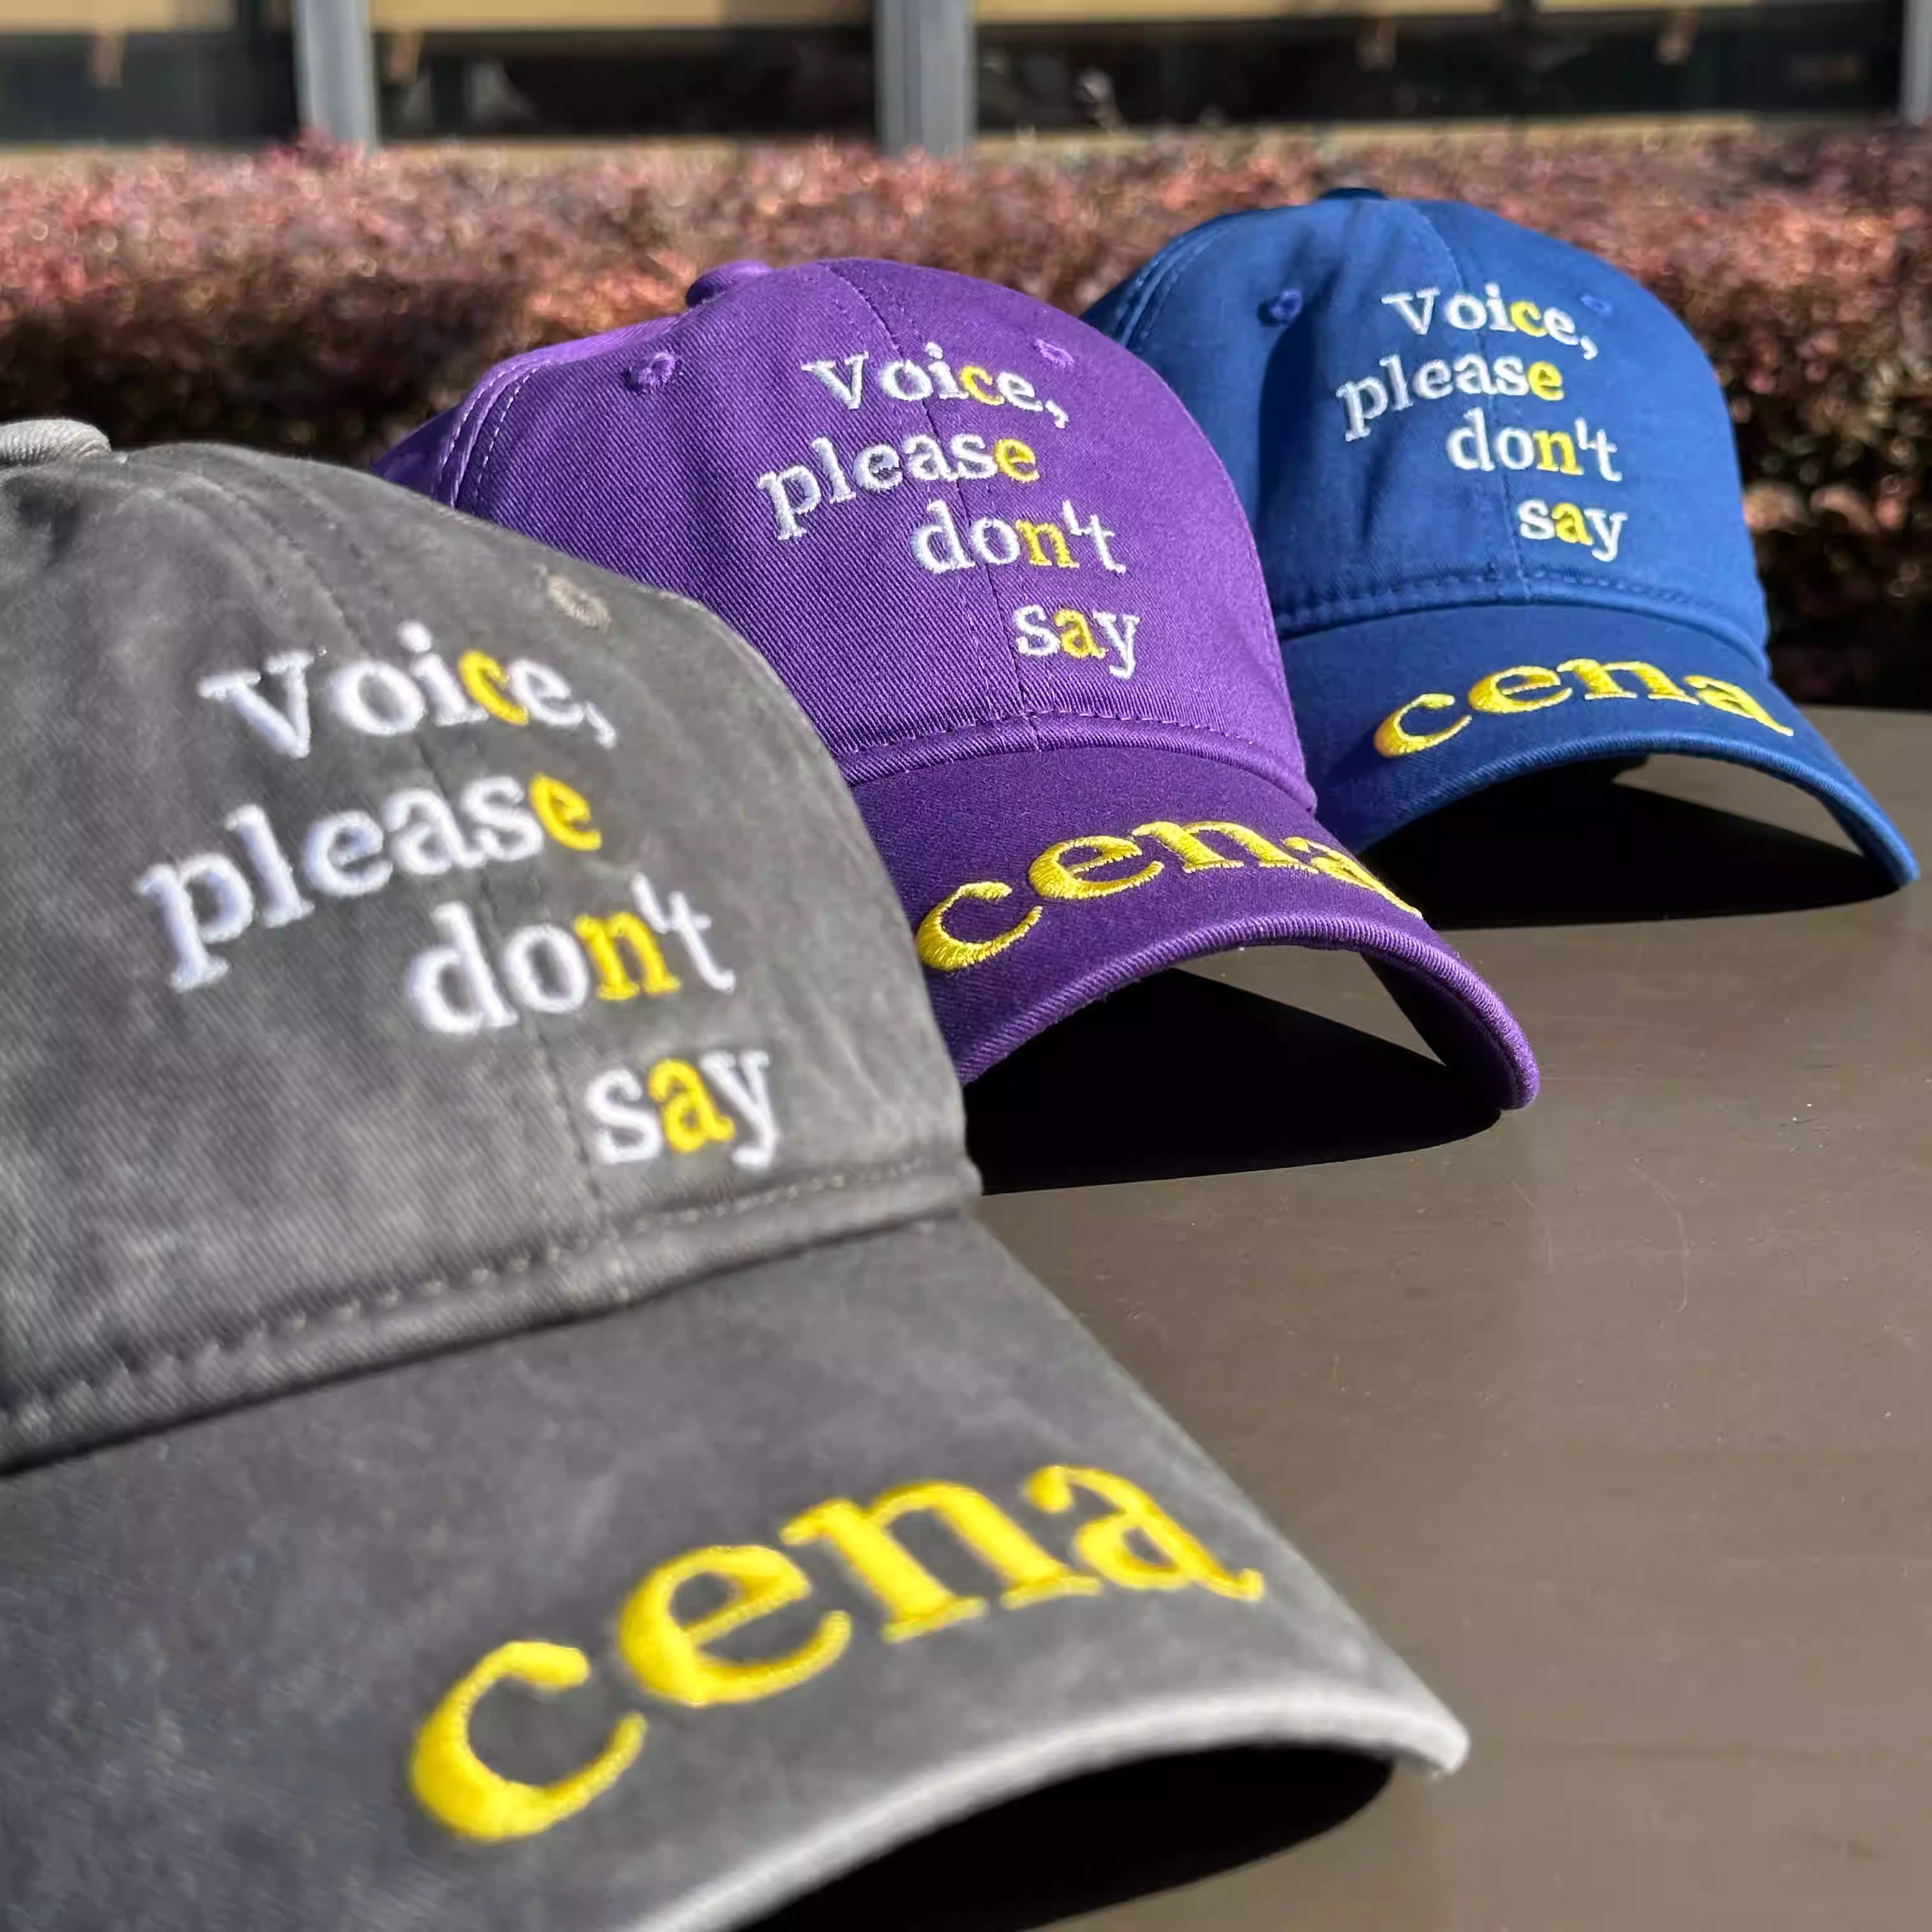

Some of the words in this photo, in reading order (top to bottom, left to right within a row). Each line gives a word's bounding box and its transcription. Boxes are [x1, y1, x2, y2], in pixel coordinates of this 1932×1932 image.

[1336, 353, 1565, 442] please
[1446, 406, 1624, 482] don't
[756, 433, 1041, 541] please
[909, 498, 1127, 574] don't
[1517, 498, 1629, 562] say
[1012, 603, 1141, 681] say
[1373, 658, 1795, 758] cena
[134, 772, 603, 994] please
[916, 820, 1424, 972] cena
[406, 872, 736, 1034] don't
[584, 1049, 779, 1170] say
[408, 1463, 1267, 1843] cena
